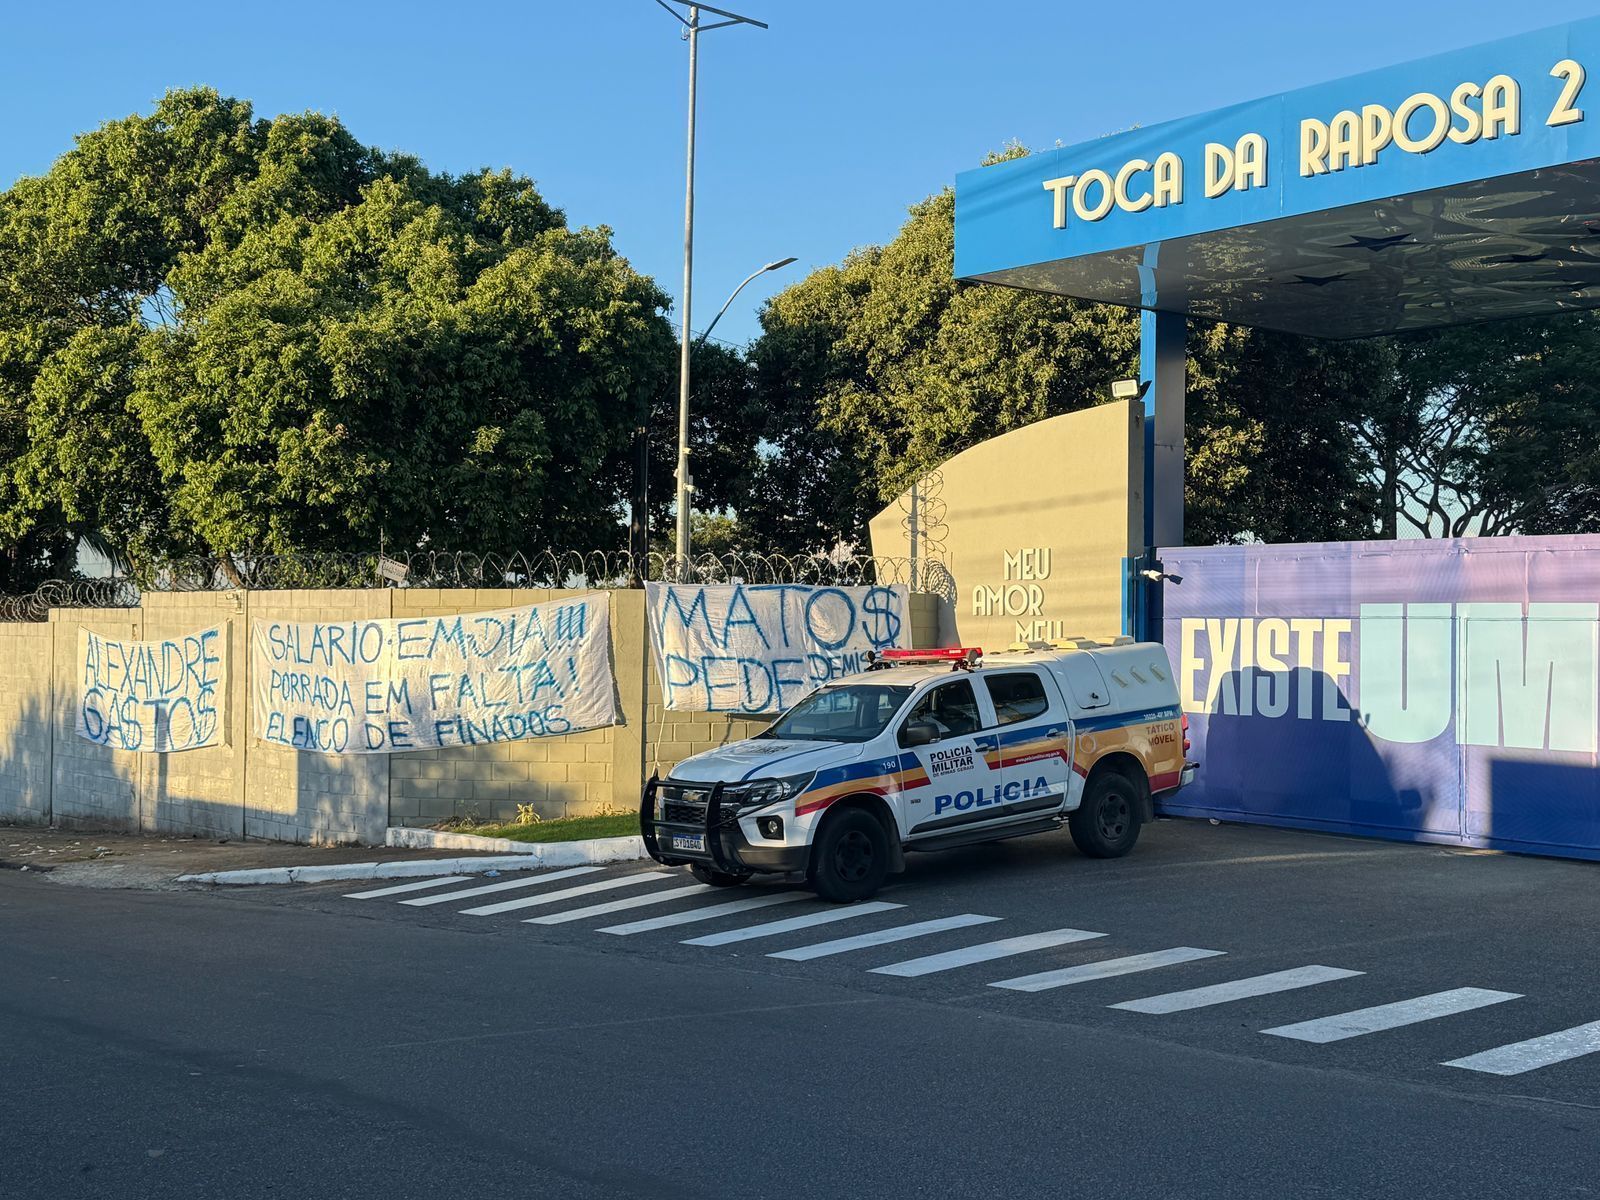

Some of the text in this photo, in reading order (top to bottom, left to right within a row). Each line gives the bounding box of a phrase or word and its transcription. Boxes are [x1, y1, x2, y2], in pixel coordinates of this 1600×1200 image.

[1043, 59, 1586, 229] TOCA DA RAPOSA 2
[1004, 548, 1051, 580] MEU
[972, 584, 1045, 616] AMOR
[85, 630, 219, 699] ALEXANDRE
[270, 657, 582, 716] PORRADA EM FALTA!
[666, 654, 804, 712] PEDE
[1181, 602, 1598, 752] EXISTE UM
[266, 712, 349, 752] ELENCO
[365, 721, 413, 750] DE
[883, 761, 896, 769] 190
[931, 757, 973, 773] MILITAR
